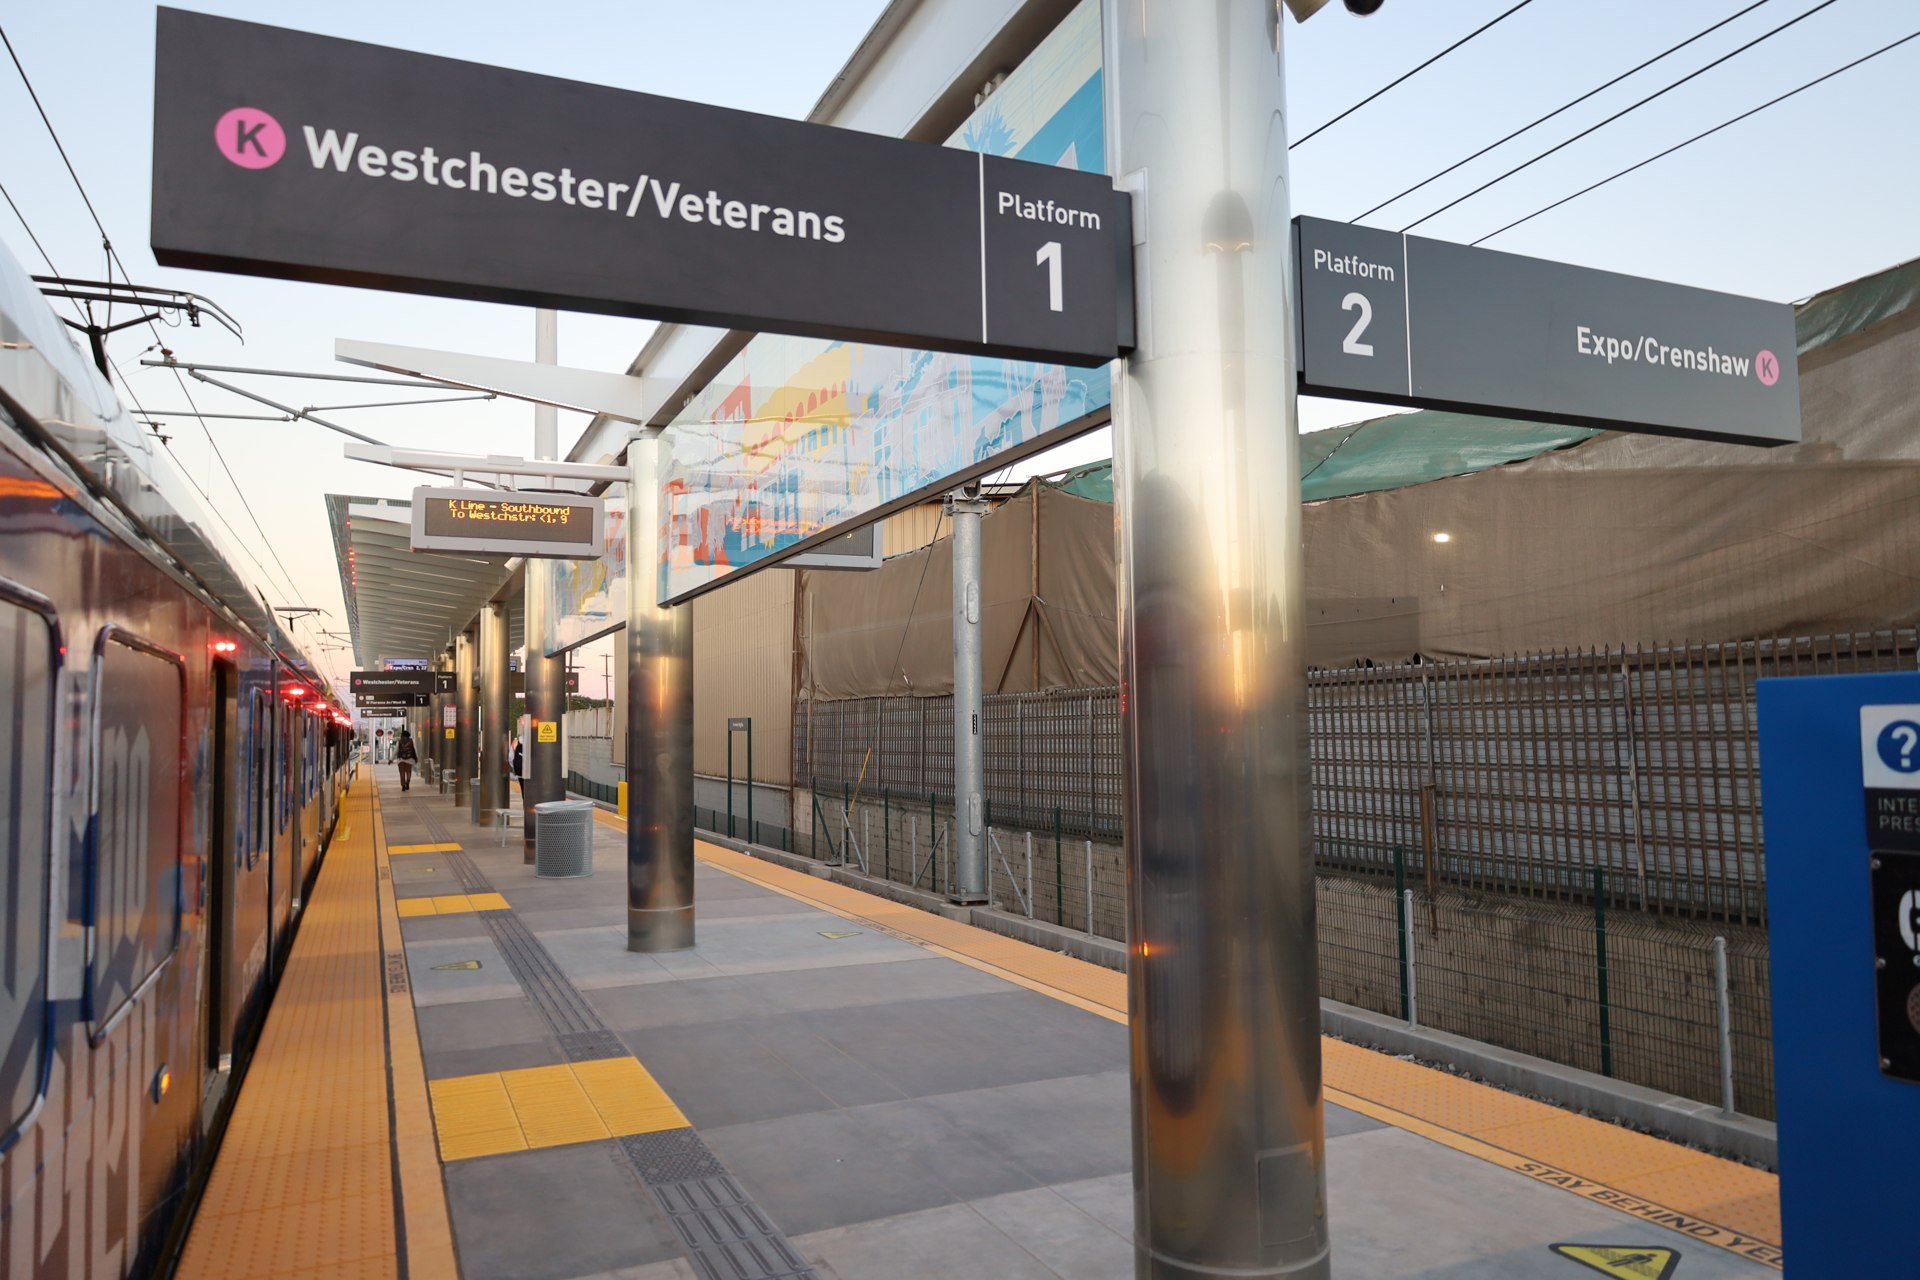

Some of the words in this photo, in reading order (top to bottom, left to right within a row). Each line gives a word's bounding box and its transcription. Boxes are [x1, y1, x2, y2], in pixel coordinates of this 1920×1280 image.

[302, 124, 847, 244] Westchester/Veterans
[998, 191, 1101, 230] Platform
[1036, 241, 1063, 312] 1
[1313, 248, 1395, 282] Platform
[1341, 292, 1374, 357] 2
[1576, 325, 1750, 378] Expo/Crenshaw
[449, 499, 456, 509] K
[461, 500, 486, 511] Line
[501, 502, 570, 516] Southbound
[450, 508, 465, 519] To
[469, 509, 537, 522] Westchstr:
[442, 680, 448, 689] 1
[1514, 1162, 1596, 1190] STAY
[1592, 1189, 1721, 1238] BEHIND
